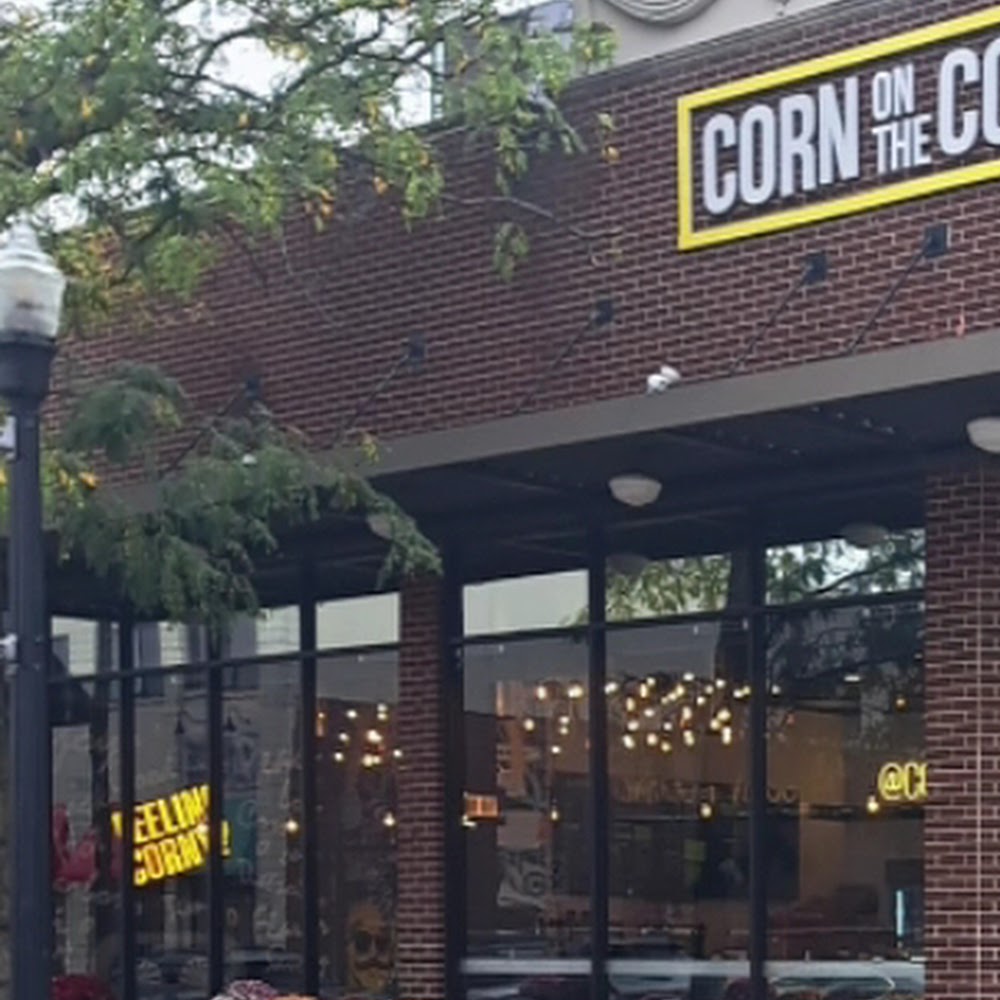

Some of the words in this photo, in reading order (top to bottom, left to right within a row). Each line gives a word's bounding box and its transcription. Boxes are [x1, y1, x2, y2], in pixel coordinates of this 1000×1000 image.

[872, 64, 914, 121] ON
[702, 77, 859, 215] CORN
[872, 113, 931, 174] THE
